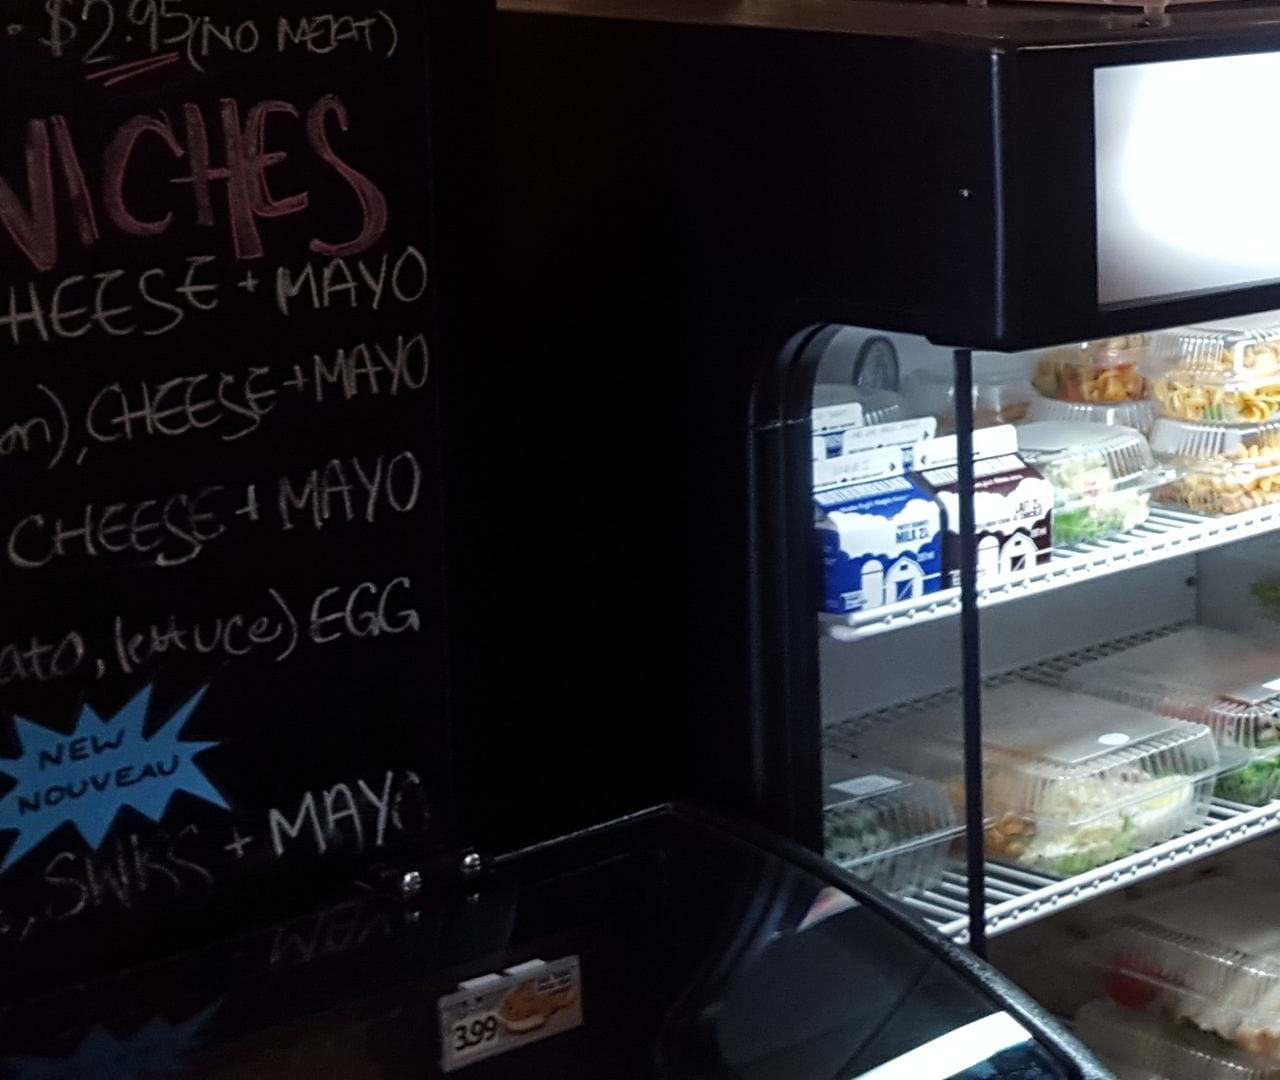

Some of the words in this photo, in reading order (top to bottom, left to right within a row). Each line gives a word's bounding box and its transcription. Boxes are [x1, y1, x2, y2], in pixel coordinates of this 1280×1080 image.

[275, 244, 428, 316] MAYO
[86, 366, 278, 442] CHEESE
[313, 332, 430, 403] MAYO
[7, 485, 227, 569] CHEESE
[278, 450, 423, 532] MAYO
[310, 576, 421, 643] EGG
[39, 727, 125, 770] NEW
[17, 754, 180, 816] NOUVEAU
